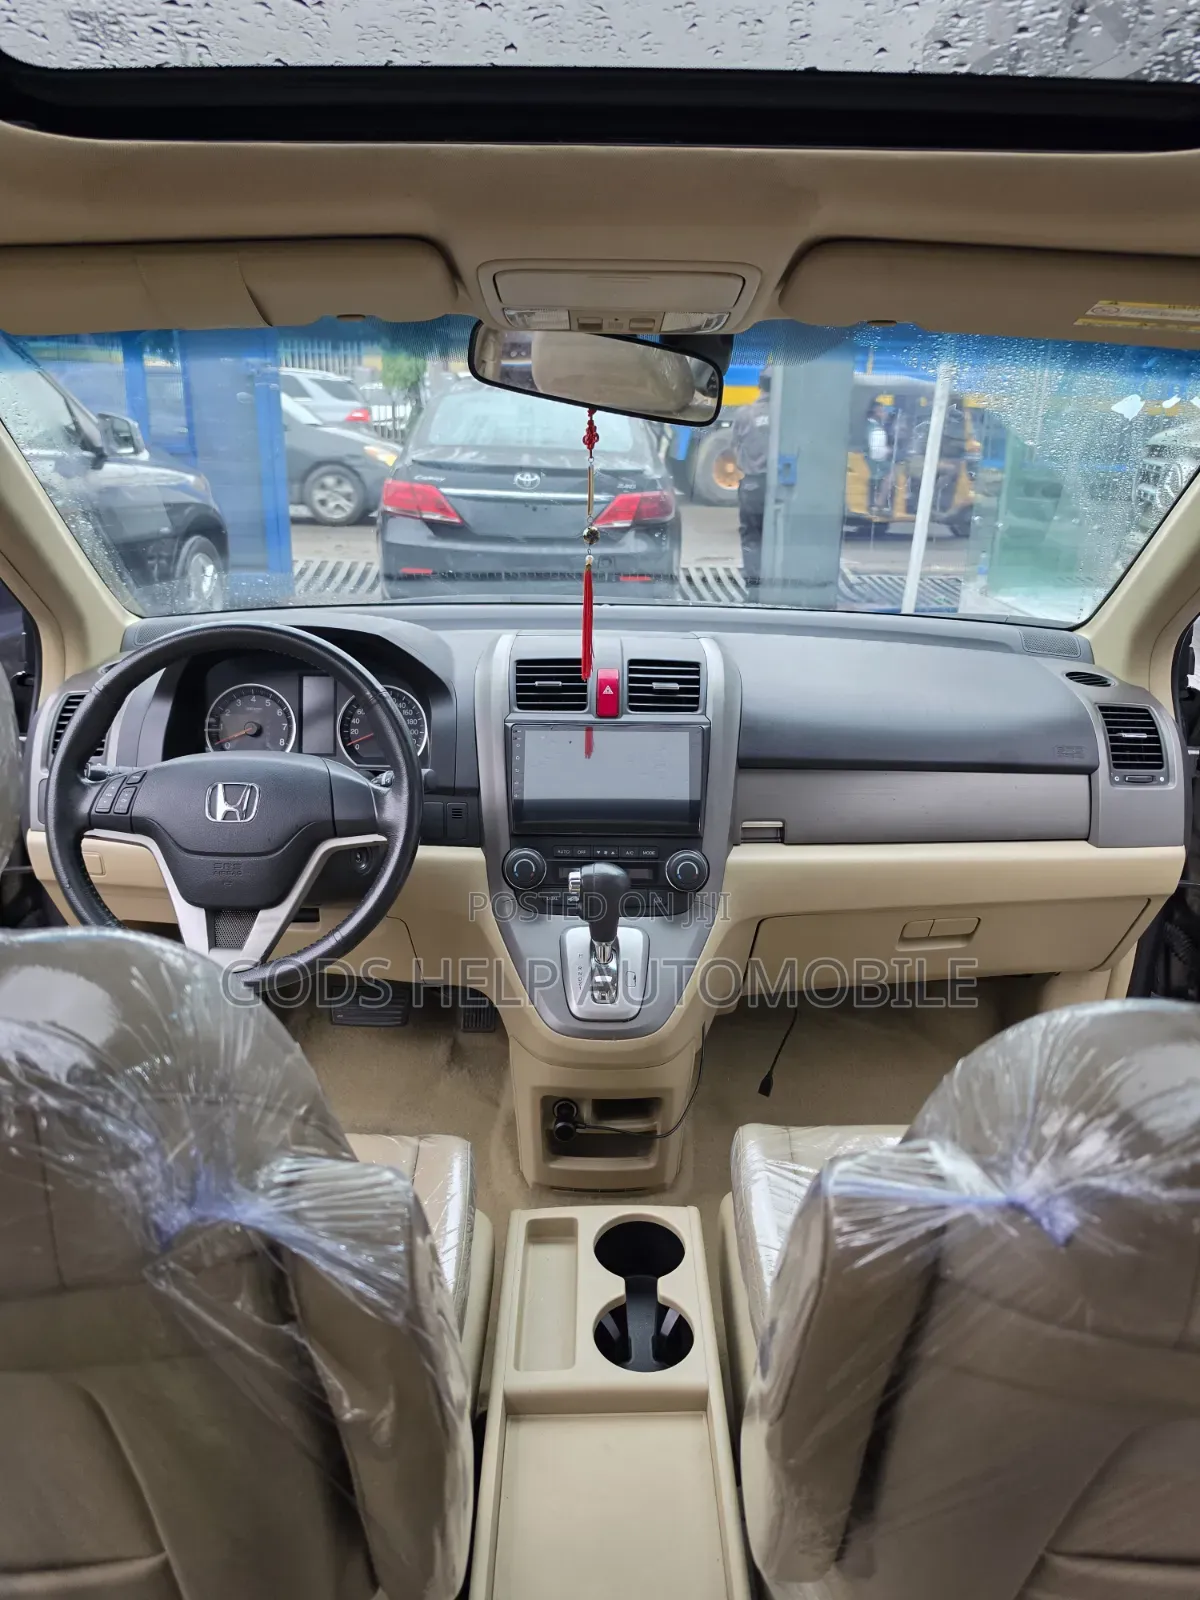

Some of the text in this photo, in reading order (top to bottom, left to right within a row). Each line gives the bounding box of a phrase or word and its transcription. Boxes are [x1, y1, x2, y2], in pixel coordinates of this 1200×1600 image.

[236, 699, 242, 707] 3
[276, 709, 283, 717] 6
[279, 738, 285, 746] 8
